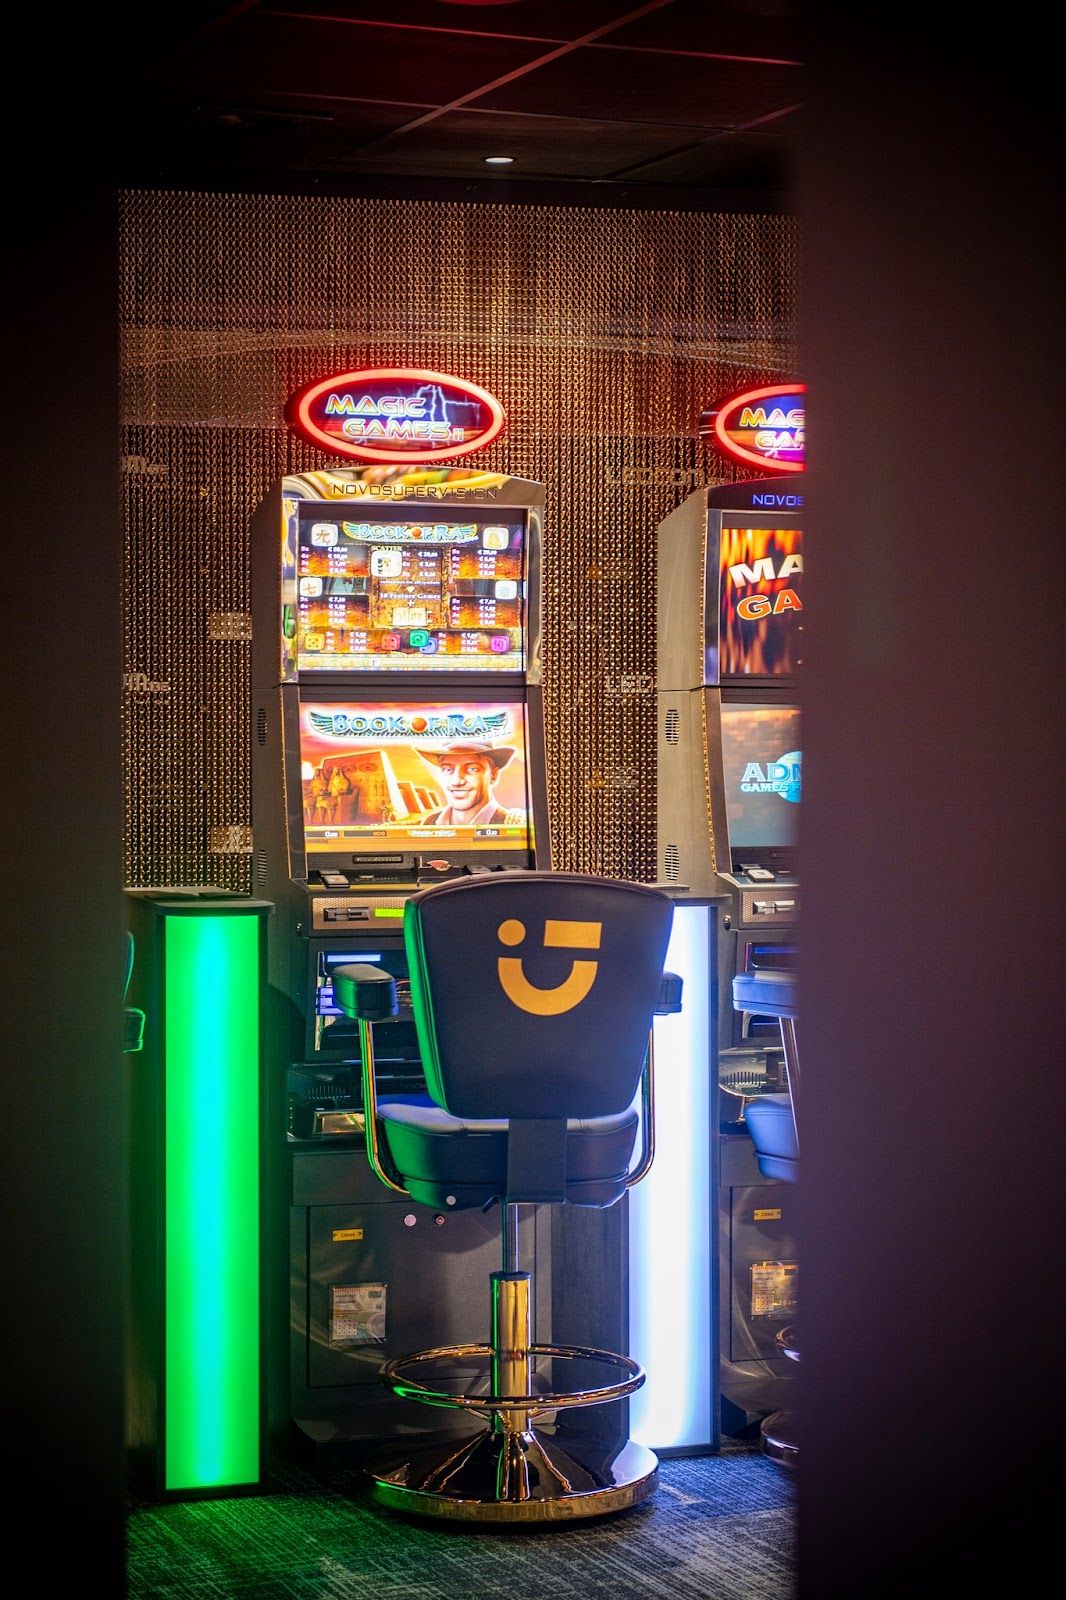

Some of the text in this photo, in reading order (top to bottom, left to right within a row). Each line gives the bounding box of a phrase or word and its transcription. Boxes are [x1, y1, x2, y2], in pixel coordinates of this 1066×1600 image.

[325, 393, 426, 417] MAGIC
[343, 418, 451, 440] GAMES
[333, 484, 498, 499] NOVOSUPERVISION
[359, 523, 408, 539] BOOK
[434, 525, 464, 539] RA
[332, 714, 407, 733] BOOK
[447, 714, 487, 734] RA
[740, 782, 788, 793] GAMES
